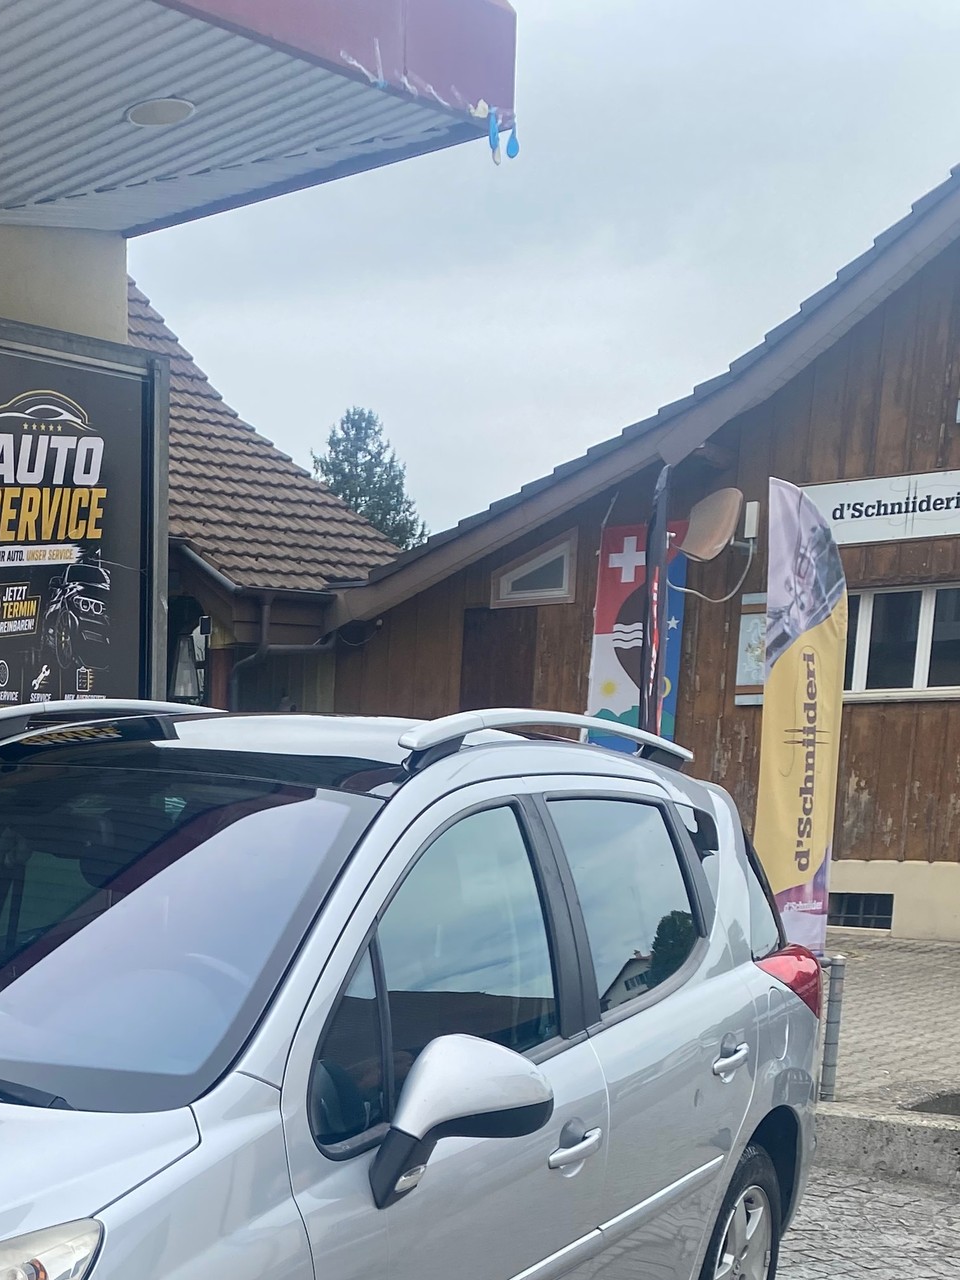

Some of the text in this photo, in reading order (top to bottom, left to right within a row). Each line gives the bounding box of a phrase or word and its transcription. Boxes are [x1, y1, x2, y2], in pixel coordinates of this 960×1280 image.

[6, 549, 25, 562] AUTO.
[26, 548, 47, 561] UNSER
[2, 585, 28, 602] JETZT
[2, 600, 37, 620] TERMIN
[30, 693, 52, 702] SERVICE
